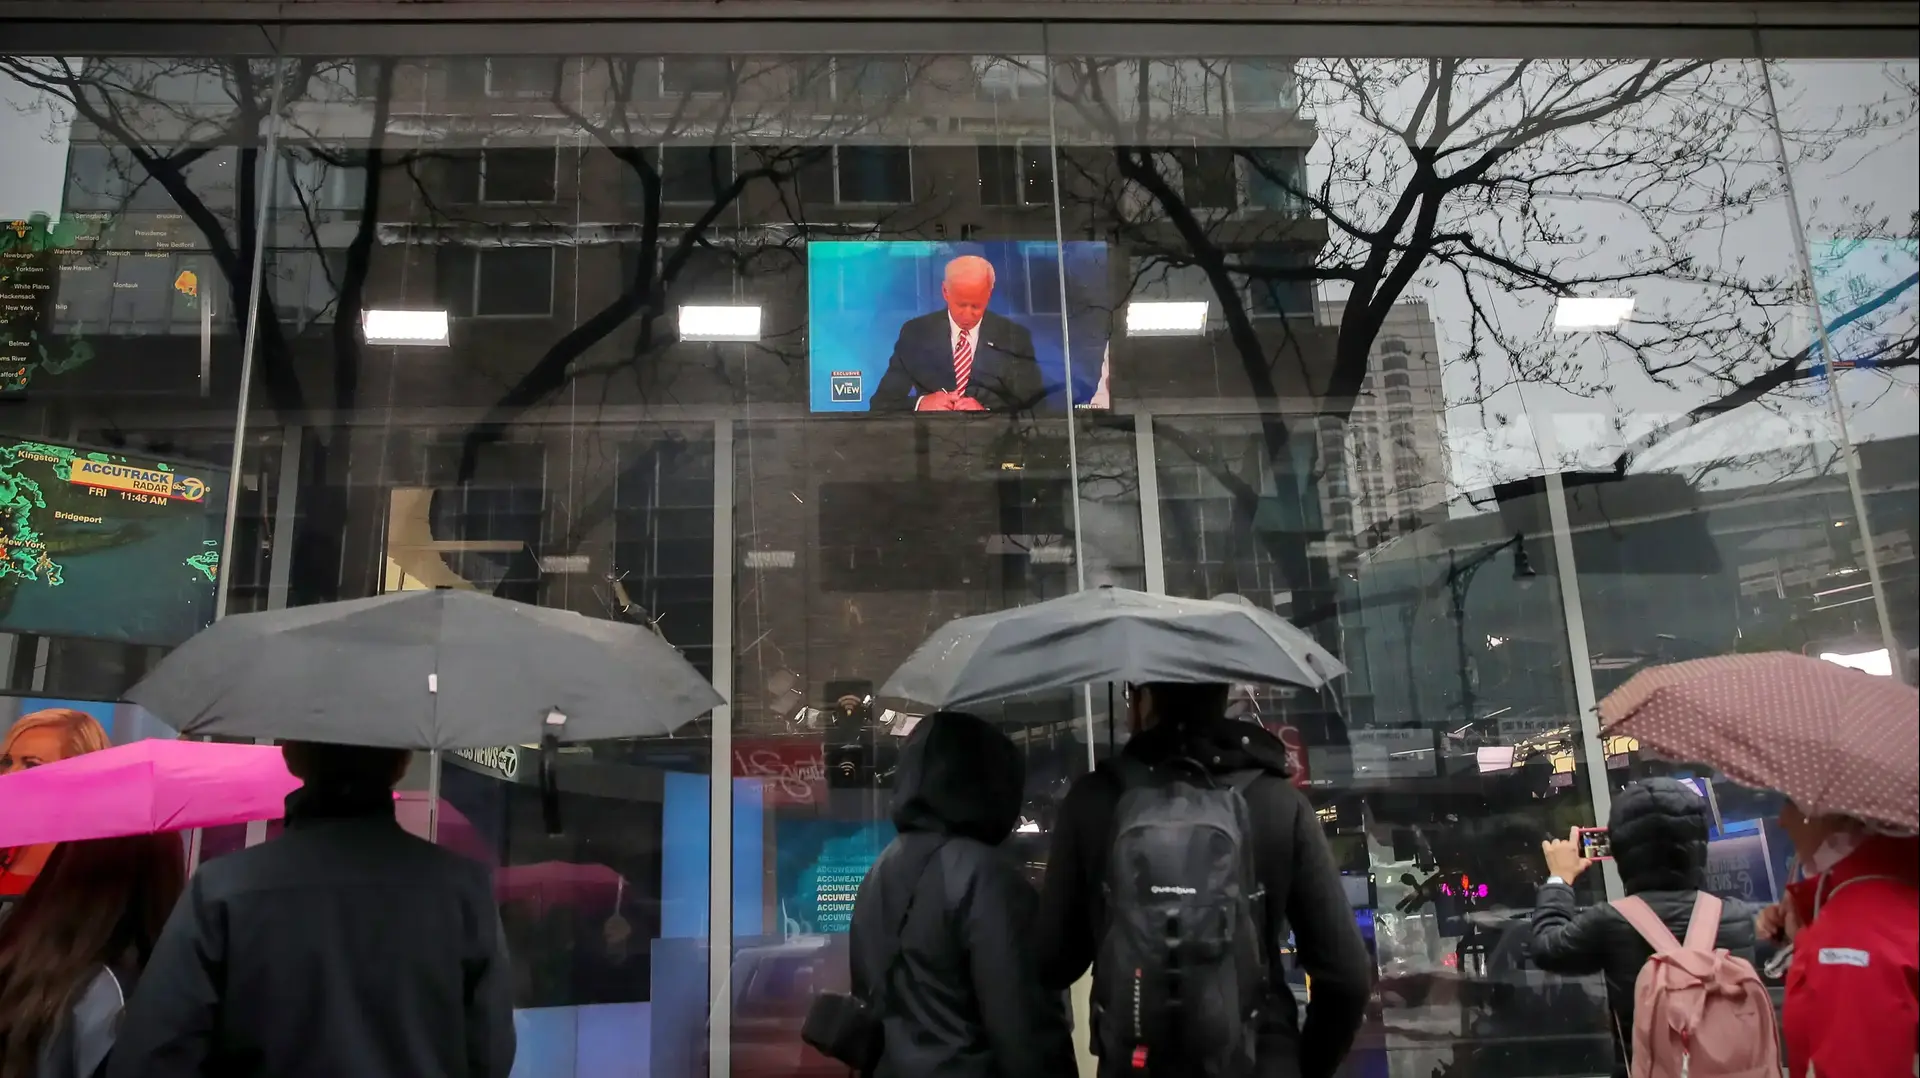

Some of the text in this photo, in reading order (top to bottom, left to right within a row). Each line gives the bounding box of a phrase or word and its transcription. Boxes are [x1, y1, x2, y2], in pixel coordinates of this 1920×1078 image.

[54, 248, 83, 256] Waterbury
[18, 450, 59, 463] Kingston
[82, 462, 169, 484] ACCUTRACK
[133, 480, 168, 493] RADAR
[88, 487, 168, 506] FRI 11:45 AM
[54, 511, 102, 523] Bridgeport
[25, 540, 45, 549] York
[474, 746, 498, 768] NEWS
[817, 914, 853, 922] ACCUWE
